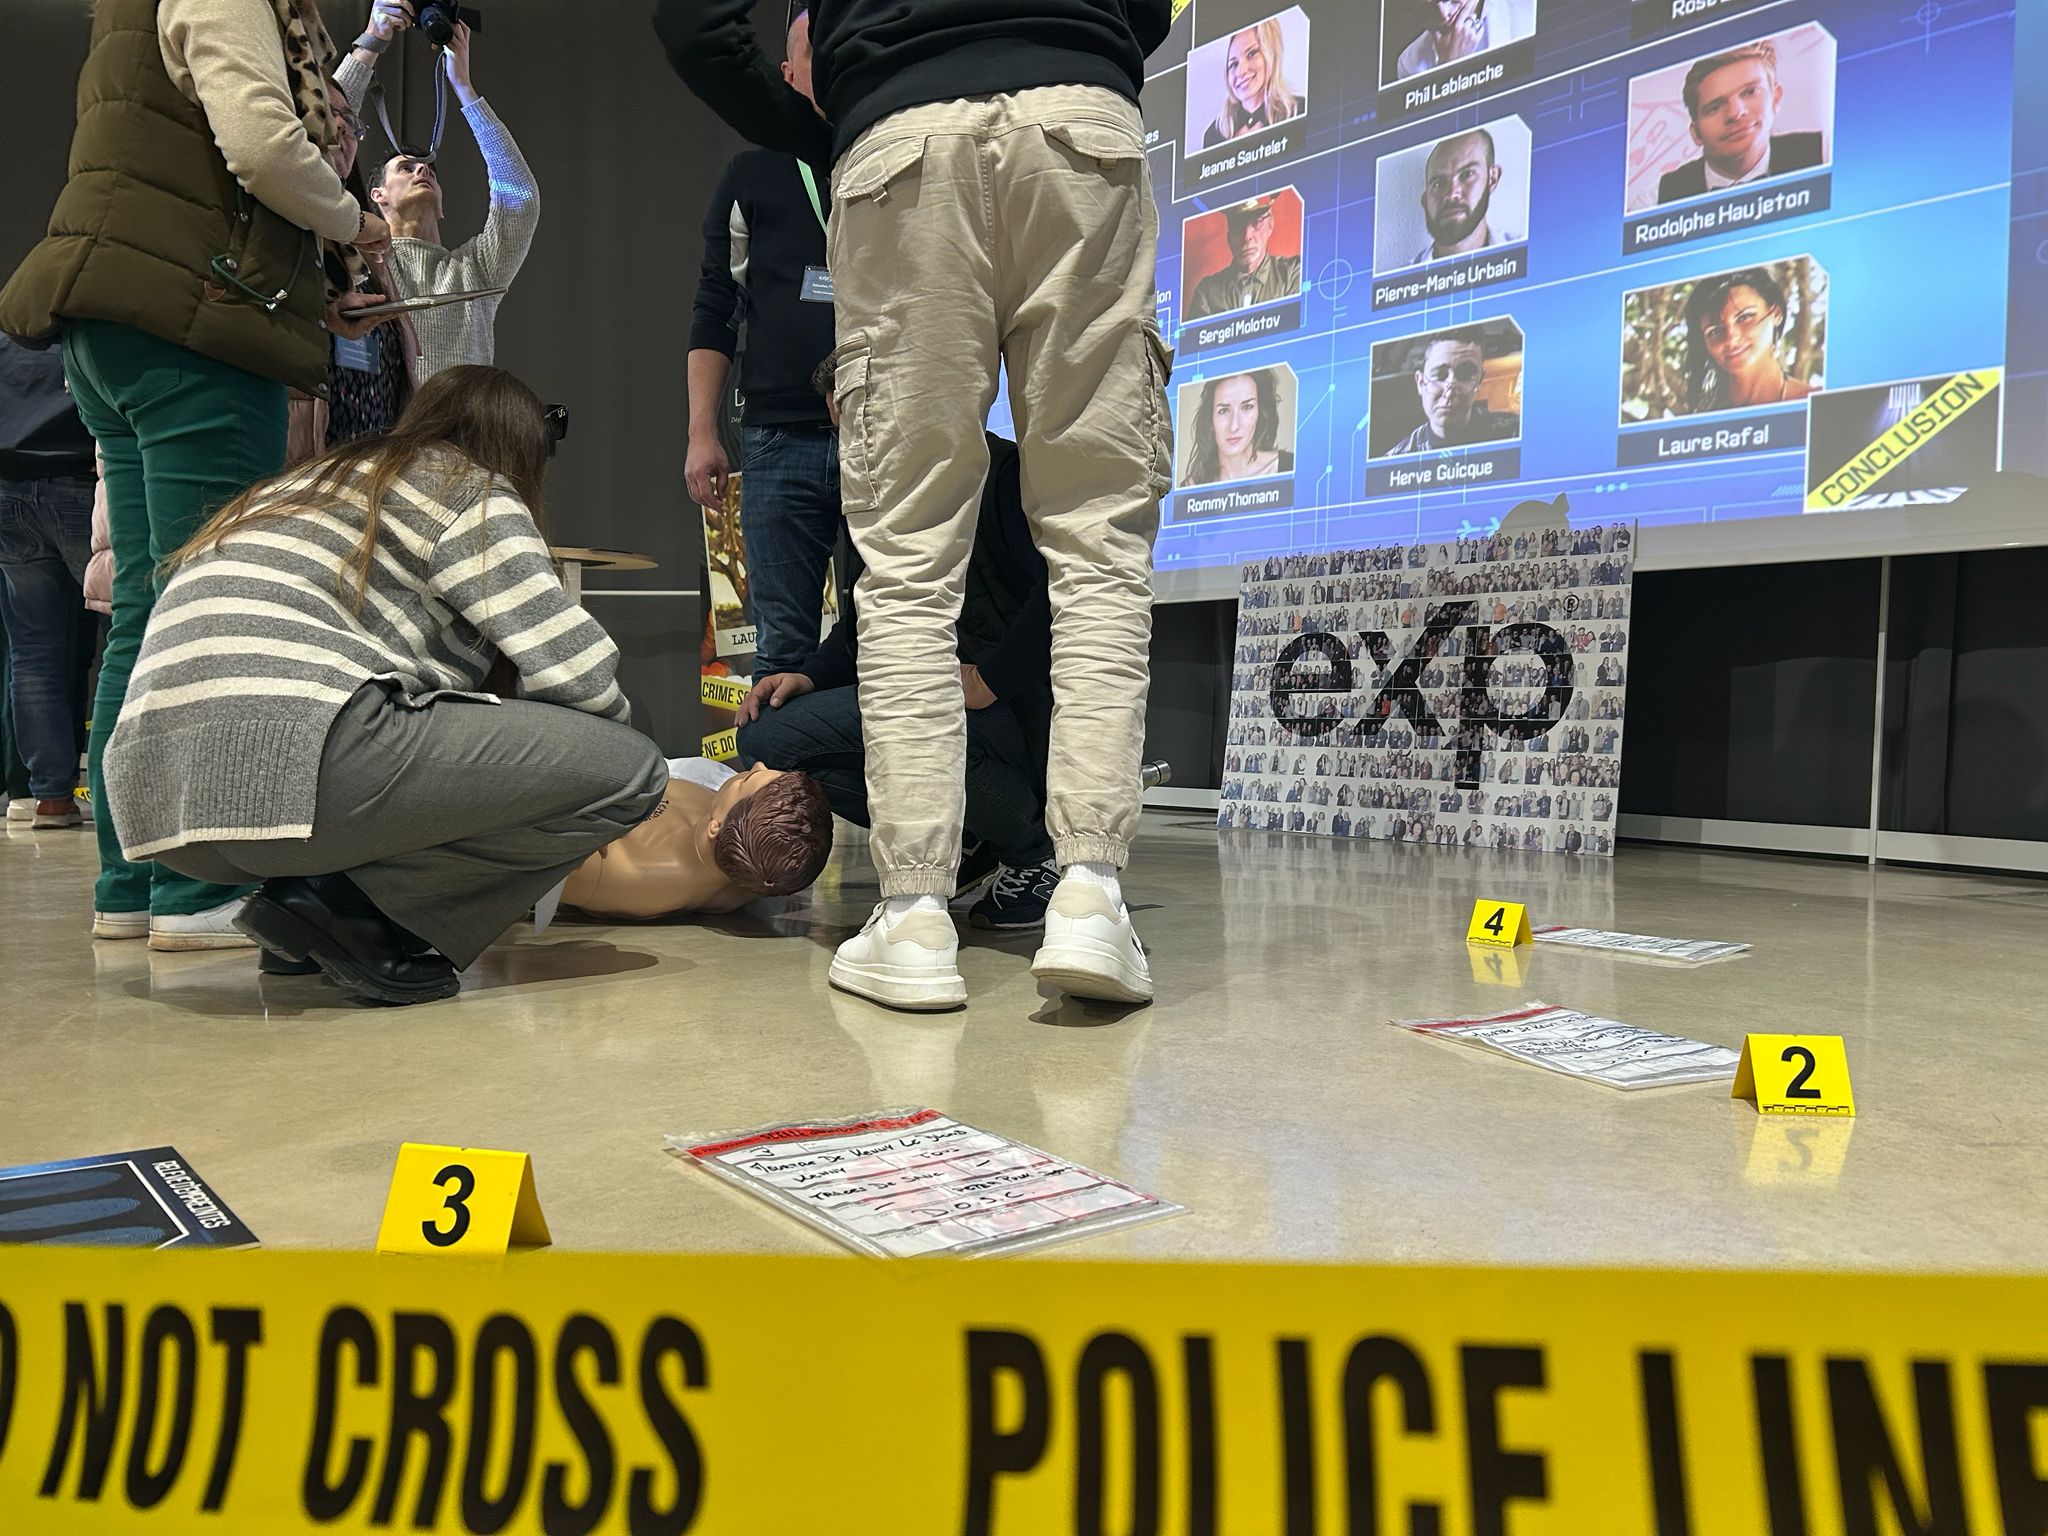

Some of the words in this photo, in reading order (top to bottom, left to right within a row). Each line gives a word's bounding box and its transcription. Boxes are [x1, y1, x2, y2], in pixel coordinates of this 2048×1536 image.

[1405, 85, 1430, 109] Phil
[1432, 64, 1504, 101] Lablanche
[1199, 157, 1235, 180] Jeanne
[1237, 136, 1288, 166] Sautelet
[1635, 212, 1715, 244] Rodolphe
[1375, 270, 1465, 305] Pierre-Marie
[1468, 258, 1517, 284] Urbain
[1199, 323, 1234, 345] Sergei
[1236, 314, 1280, 336] Molotov
[1658, 435, 1712, 457] Laure
[1821, 372, 1984, 506] CONCLUSION
[1390, 470, 1432, 487] Herve
[1436, 461, 1493, 480] Guicque
[702, 682, 734, 704] CRIME
[719, 735, 735, 754] DO
[1484, 907, 1506, 937] 4
[1781, 1046, 1821, 1099] 2
[421, 1164, 476, 1247] 3
[37, 1301, 265, 1514] NOT
[302, 1302, 711, 1536] CROSS
[961, 1323, 1550, 1536] POLICE
[1637, 1345, 2048, 1536] LINE
